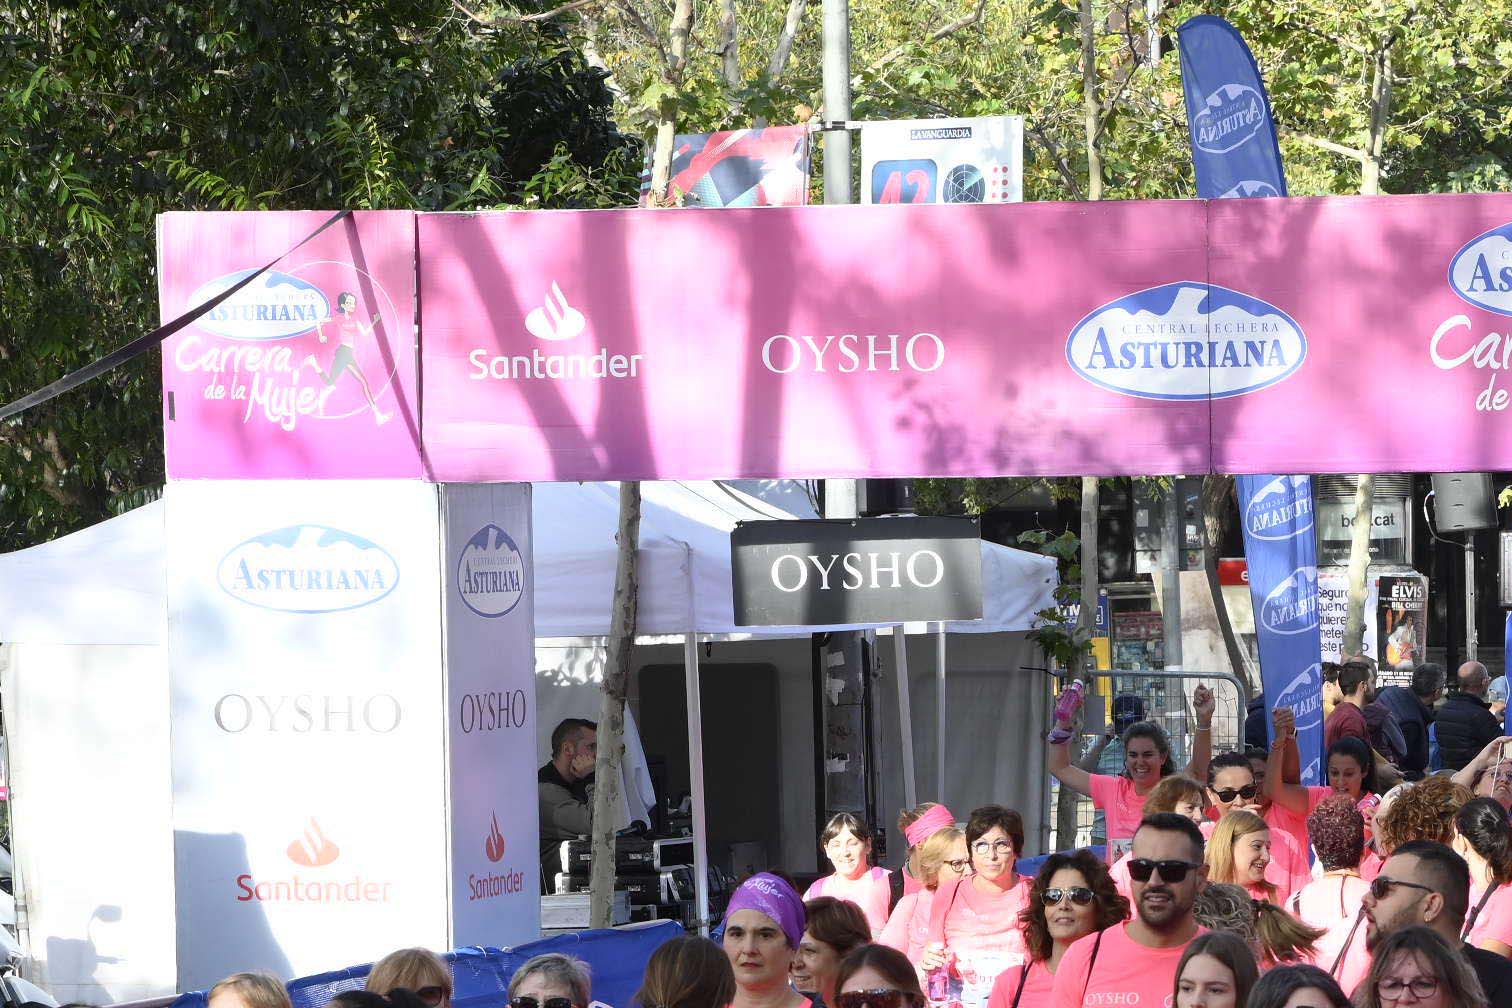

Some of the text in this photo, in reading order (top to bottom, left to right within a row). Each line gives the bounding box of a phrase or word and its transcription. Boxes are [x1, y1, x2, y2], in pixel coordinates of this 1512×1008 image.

[1121, 321, 1279, 335] CENTRAL LECHERA
[175, 336, 293, 372] Carrera
[468, 346, 644, 380] Santander
[761, 332, 945, 374] OYSHO
[1085, 330, 1287, 369] ASTURIANA
[204, 368, 337, 431] de la Mujer
[1475, 372, 1511, 412] de
[231, 557, 387, 592] ASTURIANA
[463, 560, 521, 594] ASTURIANA
[770, 550, 945, 592] OYSHO
[1391, 585, 1423, 598] ELVIS
[213, 693, 402, 734] OYSHO
[460, 689, 527, 734] OYSHO
[236, 869, 392, 904] Santander
[469, 868, 525, 902] Santander
[1085, 991, 1140, 1008] OYSHO
